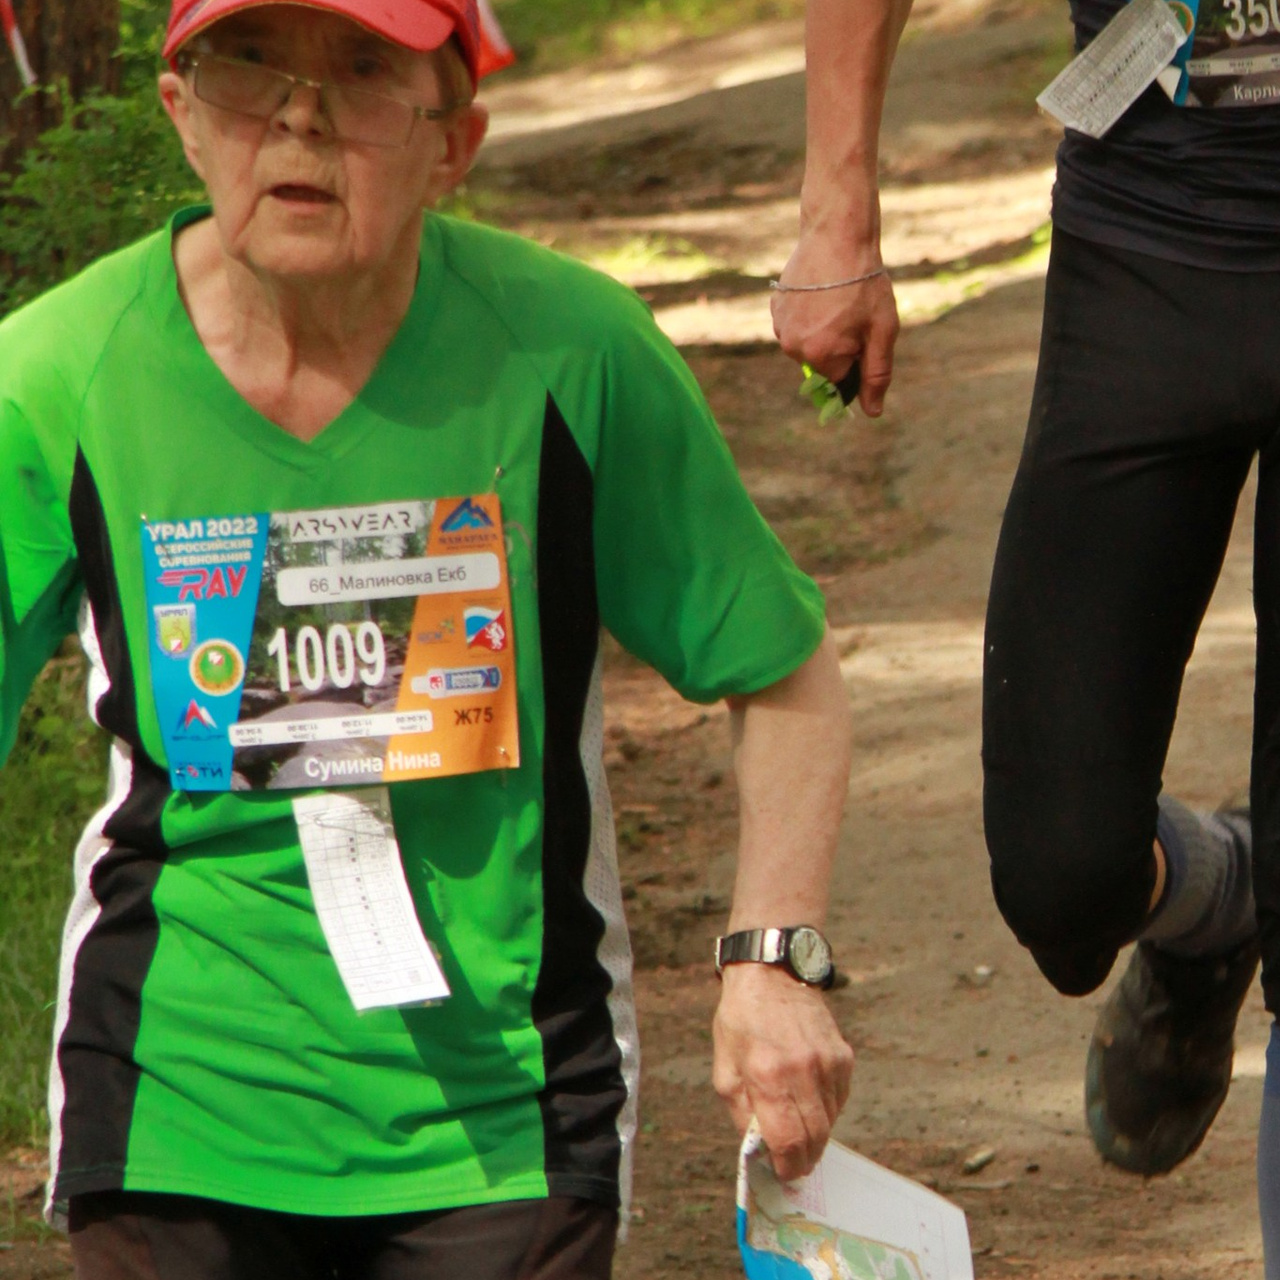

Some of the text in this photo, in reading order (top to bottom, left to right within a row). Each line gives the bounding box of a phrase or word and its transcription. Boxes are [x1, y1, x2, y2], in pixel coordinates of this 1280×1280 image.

[146, 517, 259, 542] УРАЛ 2022
[309, 566, 467, 596] 66_Малиновка Екб
[267, 621, 386, 693] 1009
[454, 707, 494, 726] Ж75
[304, 751, 442, 782] Сумина Нина
